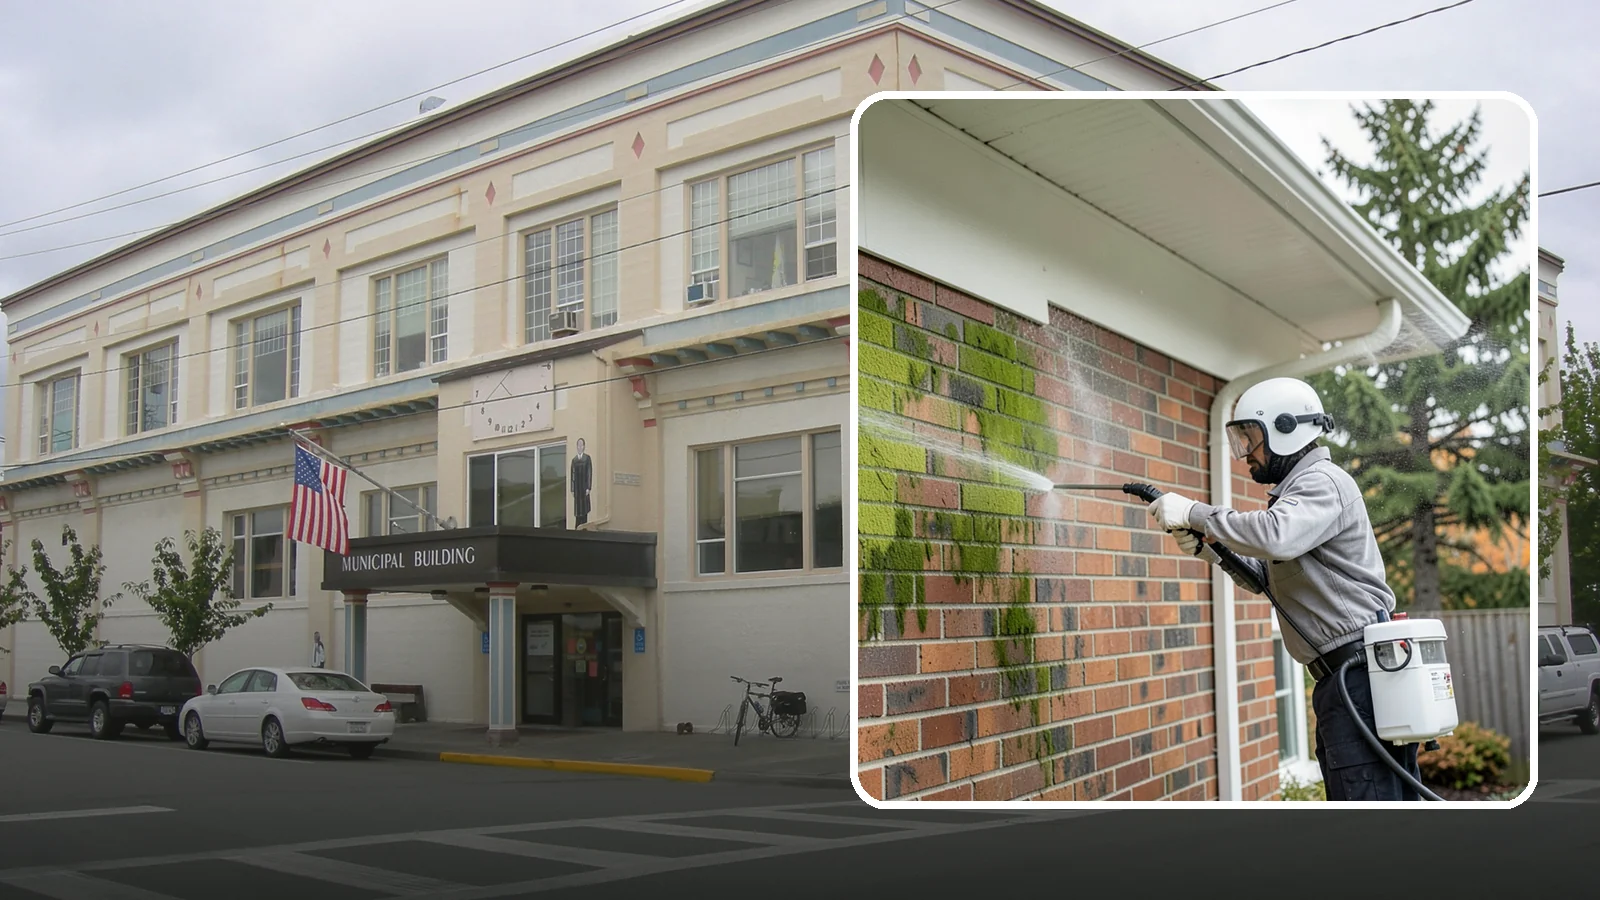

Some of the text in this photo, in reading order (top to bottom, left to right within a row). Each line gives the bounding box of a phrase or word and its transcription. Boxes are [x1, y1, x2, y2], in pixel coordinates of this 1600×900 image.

[475, 390, 479, 398] 7
[536, 402, 540, 410] 4
[480, 407, 485, 415] 8
[487, 417, 493, 426] 9
[528, 414, 533, 422] 3
[494, 423, 500, 431] 10
[521, 420, 526, 428] 2
[501, 425, 506, 433] 11
[507, 425, 513, 433] 12
[342, 546, 475, 572] MUNICIPAL BUILDING
